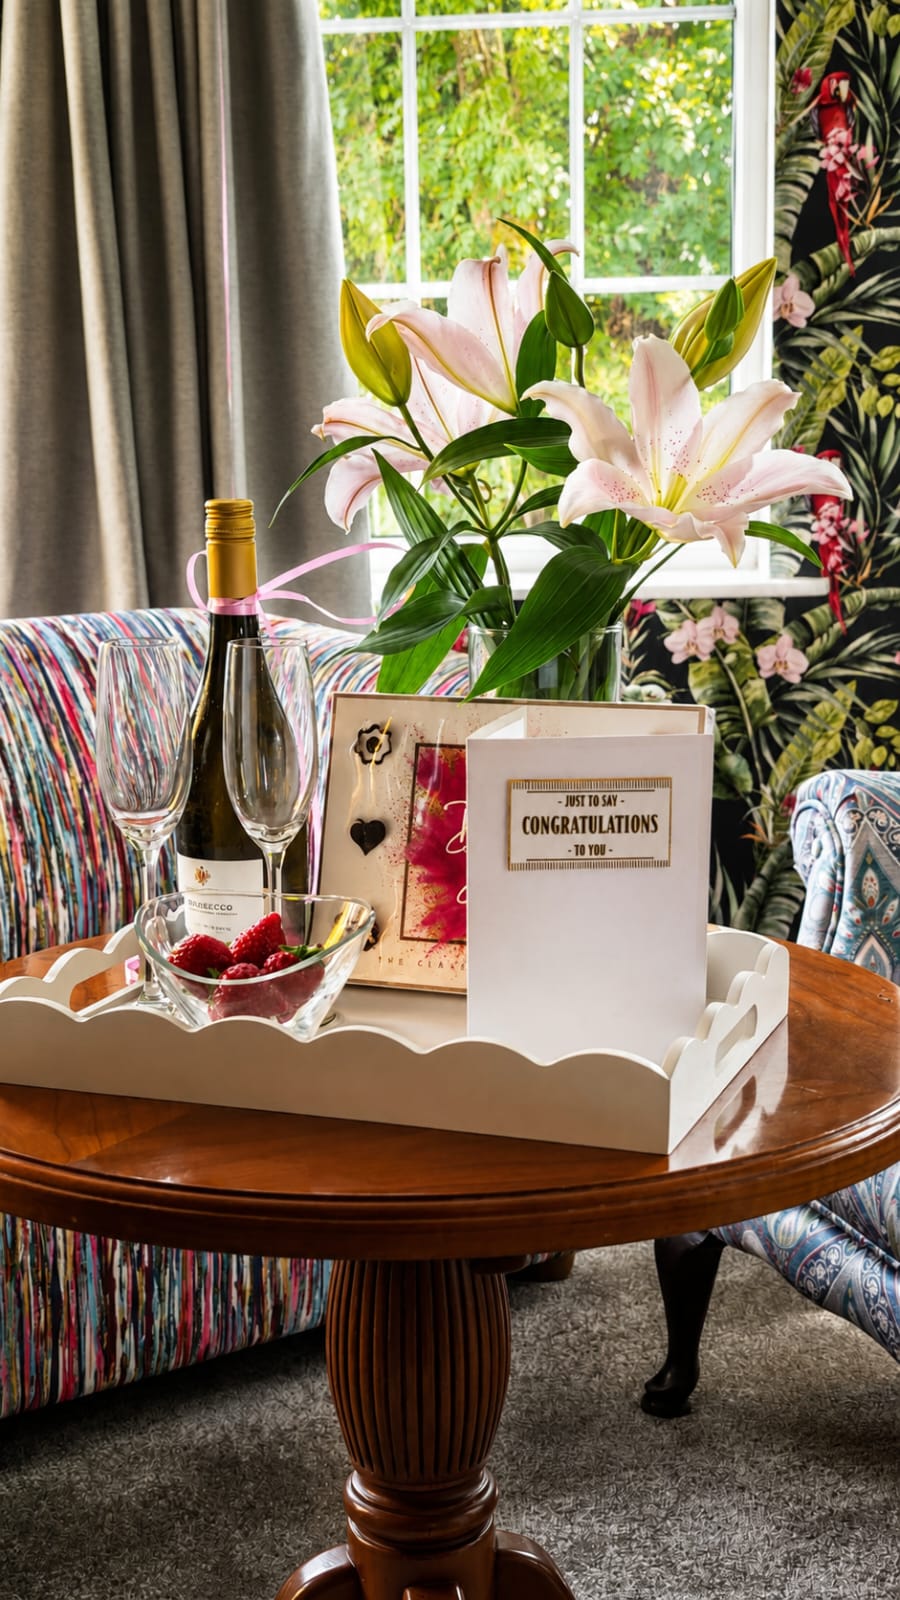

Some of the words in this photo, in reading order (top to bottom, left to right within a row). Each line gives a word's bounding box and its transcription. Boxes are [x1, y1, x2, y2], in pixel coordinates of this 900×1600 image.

[564, 794, 586, 808] JUST
[588, 794, 600, 807] TO
[601, 794, 618, 807] SAY
[522, 814, 659, 835] CONGRATULATIONS
[573, 844, 586, 857] TO
[588, 844, 607, 856] YOU
